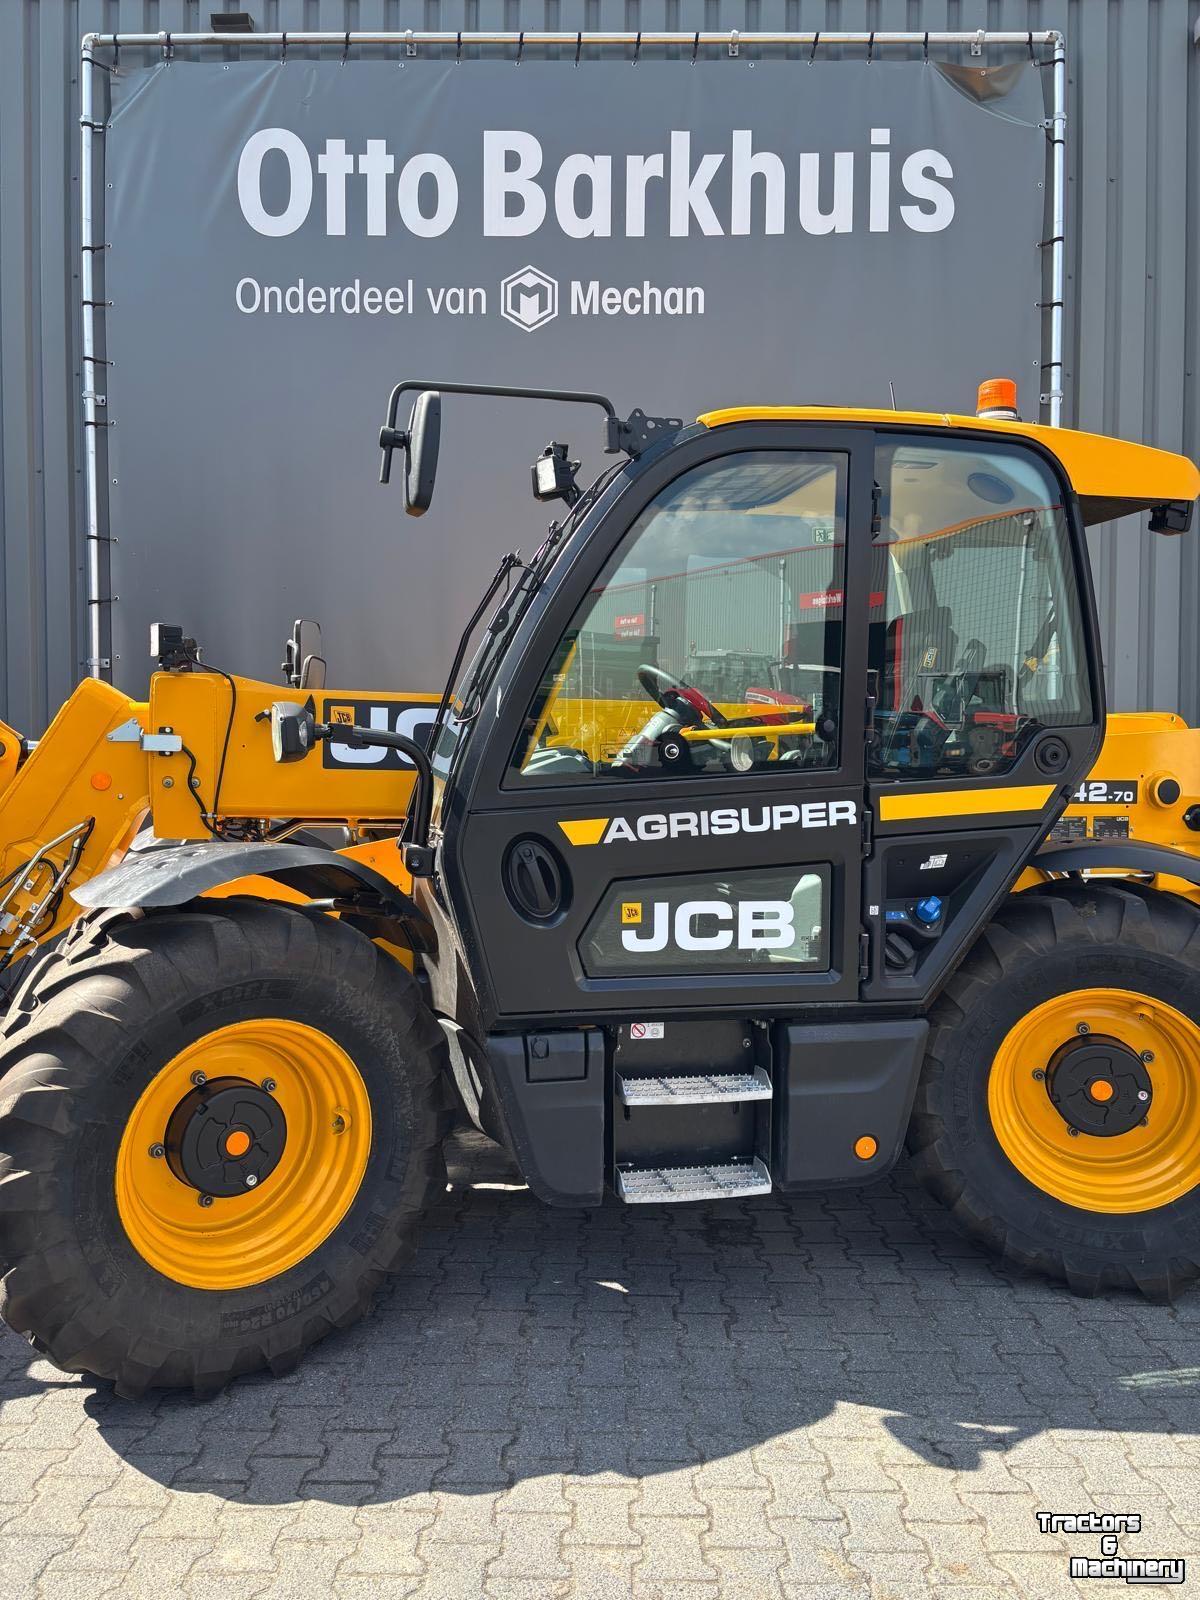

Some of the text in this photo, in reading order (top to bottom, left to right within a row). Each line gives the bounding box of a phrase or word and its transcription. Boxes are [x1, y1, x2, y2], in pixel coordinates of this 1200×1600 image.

[237, 128, 956, 238] Otto Barkhuis
[235, 277, 414, 315] Onderdeel
[427, 287, 487, 315] van
[570, 280, 705, 316] Mechan
[603, 800, 857, 844] AGRISUPER
[621, 900, 796, 953] JCB
